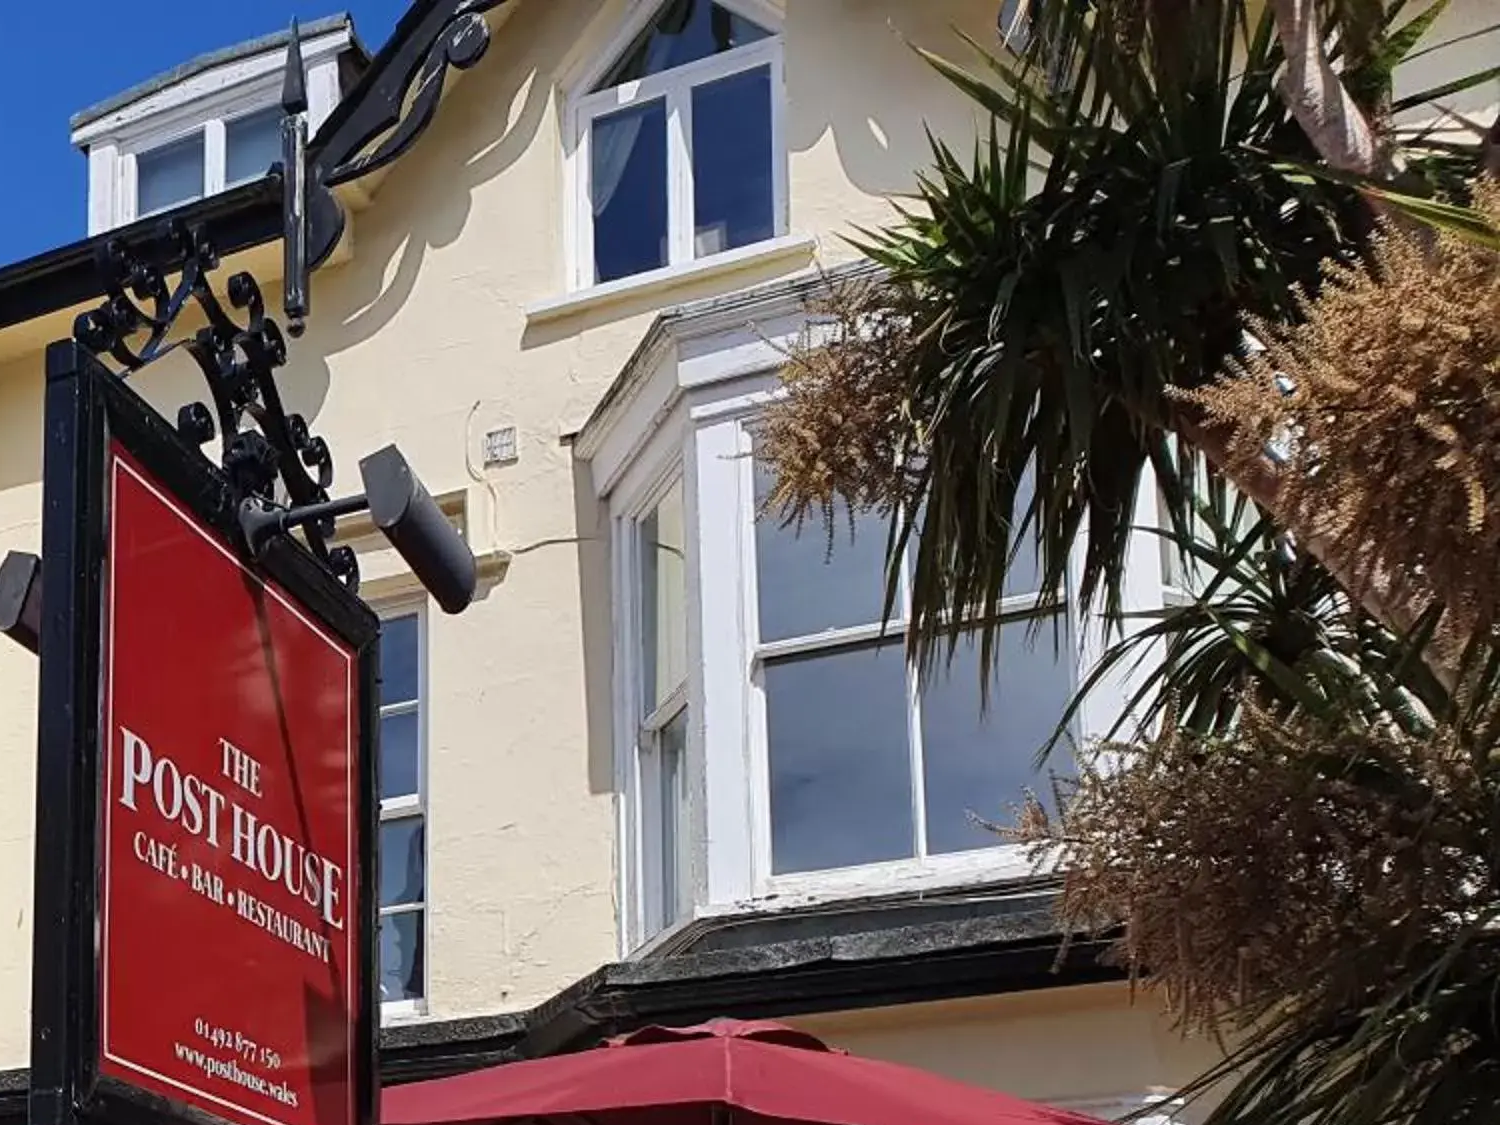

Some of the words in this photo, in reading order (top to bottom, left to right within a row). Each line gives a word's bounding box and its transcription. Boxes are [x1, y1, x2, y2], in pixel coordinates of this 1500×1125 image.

[218, 737, 263, 799] THE
[118, 725, 225, 849] POST
[231, 800, 344, 930] HOUSE
[133, 831, 179, 880] CAFÉ
[191, 863, 225, 906] BAR
[237, 892, 331, 964] RESTAURANT
[194, 1017, 233, 1050] 01492
[235, 1031, 257, 1063] 877
[174, 1042, 298, 1108] www.posthouse.wales
